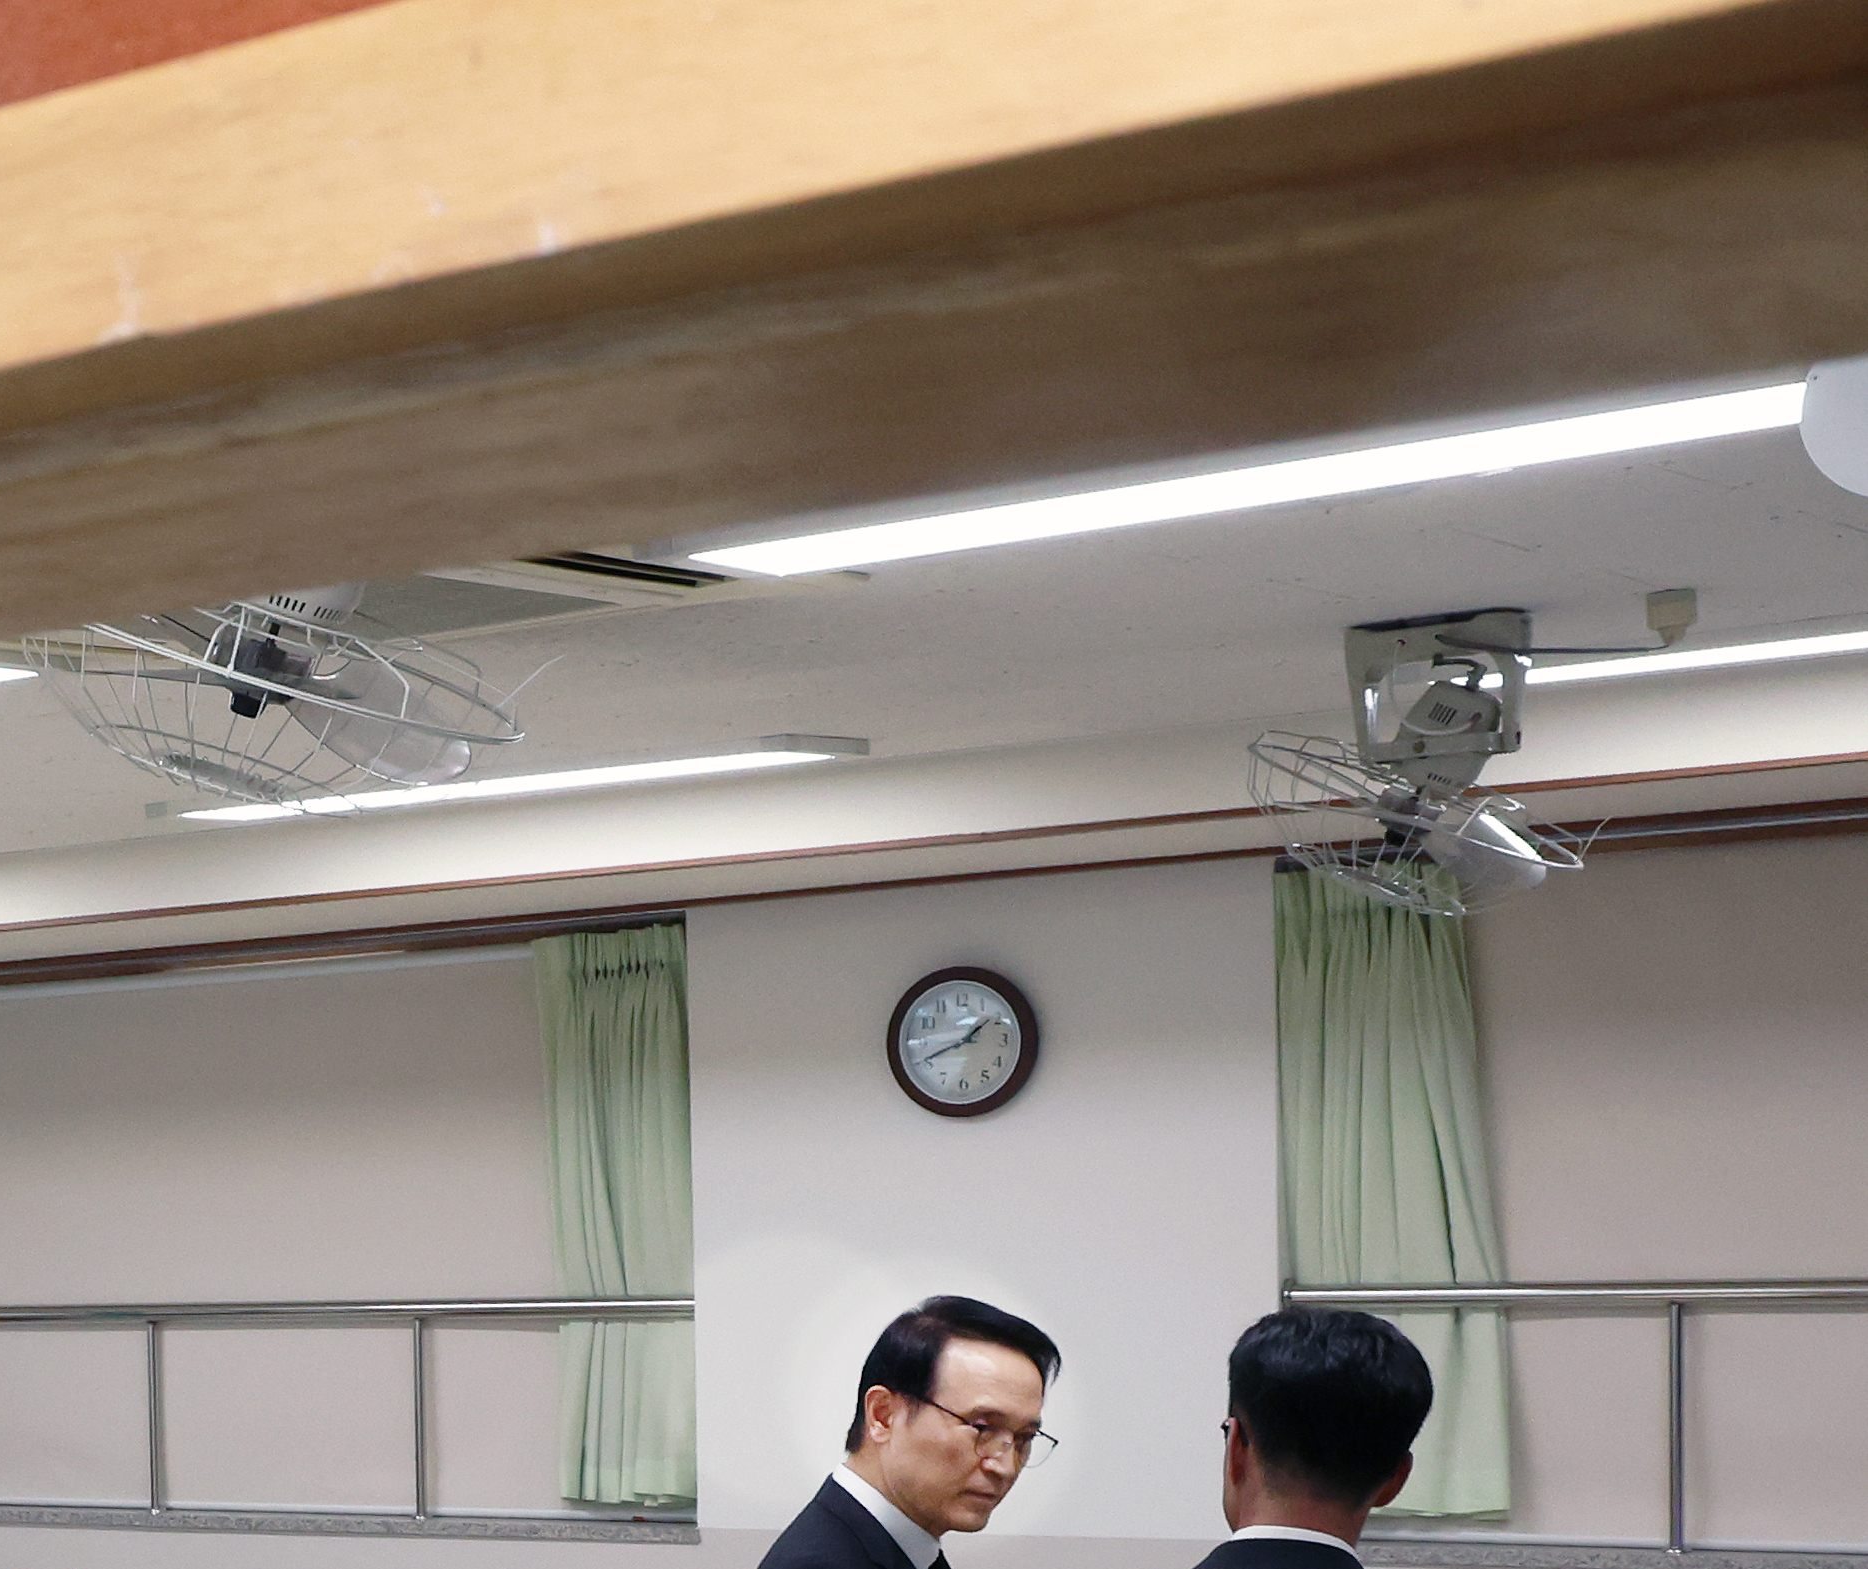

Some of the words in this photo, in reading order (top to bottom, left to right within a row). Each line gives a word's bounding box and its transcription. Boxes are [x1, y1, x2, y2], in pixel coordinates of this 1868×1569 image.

[935, 1000, 947, 1014] 11
[955, 993, 969, 1007] 12
[920, 1015, 936, 1030] 10
[999, 1033, 1009, 1048] 3
[992, 1055, 1003, 1069] 4
[980, 1070, 990, 1083] 5
[958, 1078, 969, 1091] 6
